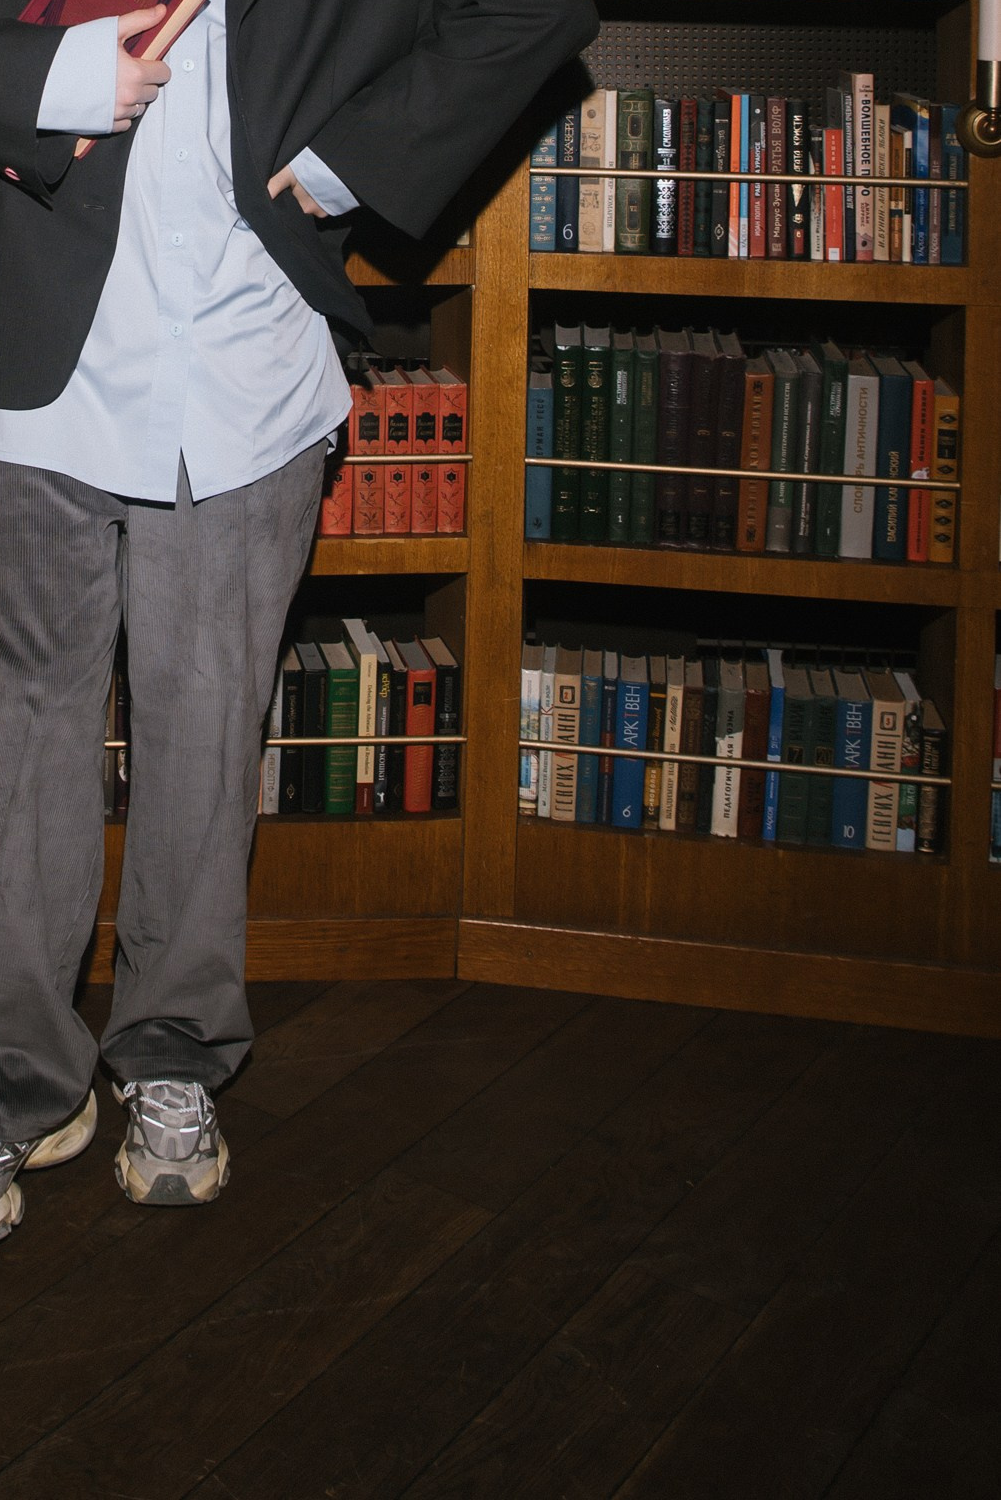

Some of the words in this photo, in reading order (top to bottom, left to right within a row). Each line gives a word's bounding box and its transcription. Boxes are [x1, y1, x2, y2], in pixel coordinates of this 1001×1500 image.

[770, 105, 782, 135] ВОЛФ
[792, 115, 802, 147] КРИСТИ
[860, 100, 872, 165] ВОЛШЕБНОЕ
[876, 118, 886, 150] ЯБЛОКИ
[771, 184, 780, 208] Зусак
[562, 223, 574, 241] 6
[771, 209, 781, 239] Маркус
[876, 210, 886, 249] И.БУНИН
[856, 386, 869, 460] АНТИЧНОСТИ
[535, 425, 545, 457] ЕРМАН
[886, 502, 899, 541] ВАСИЛИЙ
[624, 685, 641, 719] ТВЕН
[846, 702, 863, 736] ТВЕН
[378, 753, 386, 781] КОШКИ
[555, 763, 576, 813] ГЕНРИХ
[843, 824, 855, 839] 10
[871, 792, 894, 843] ГЕНРИХ
